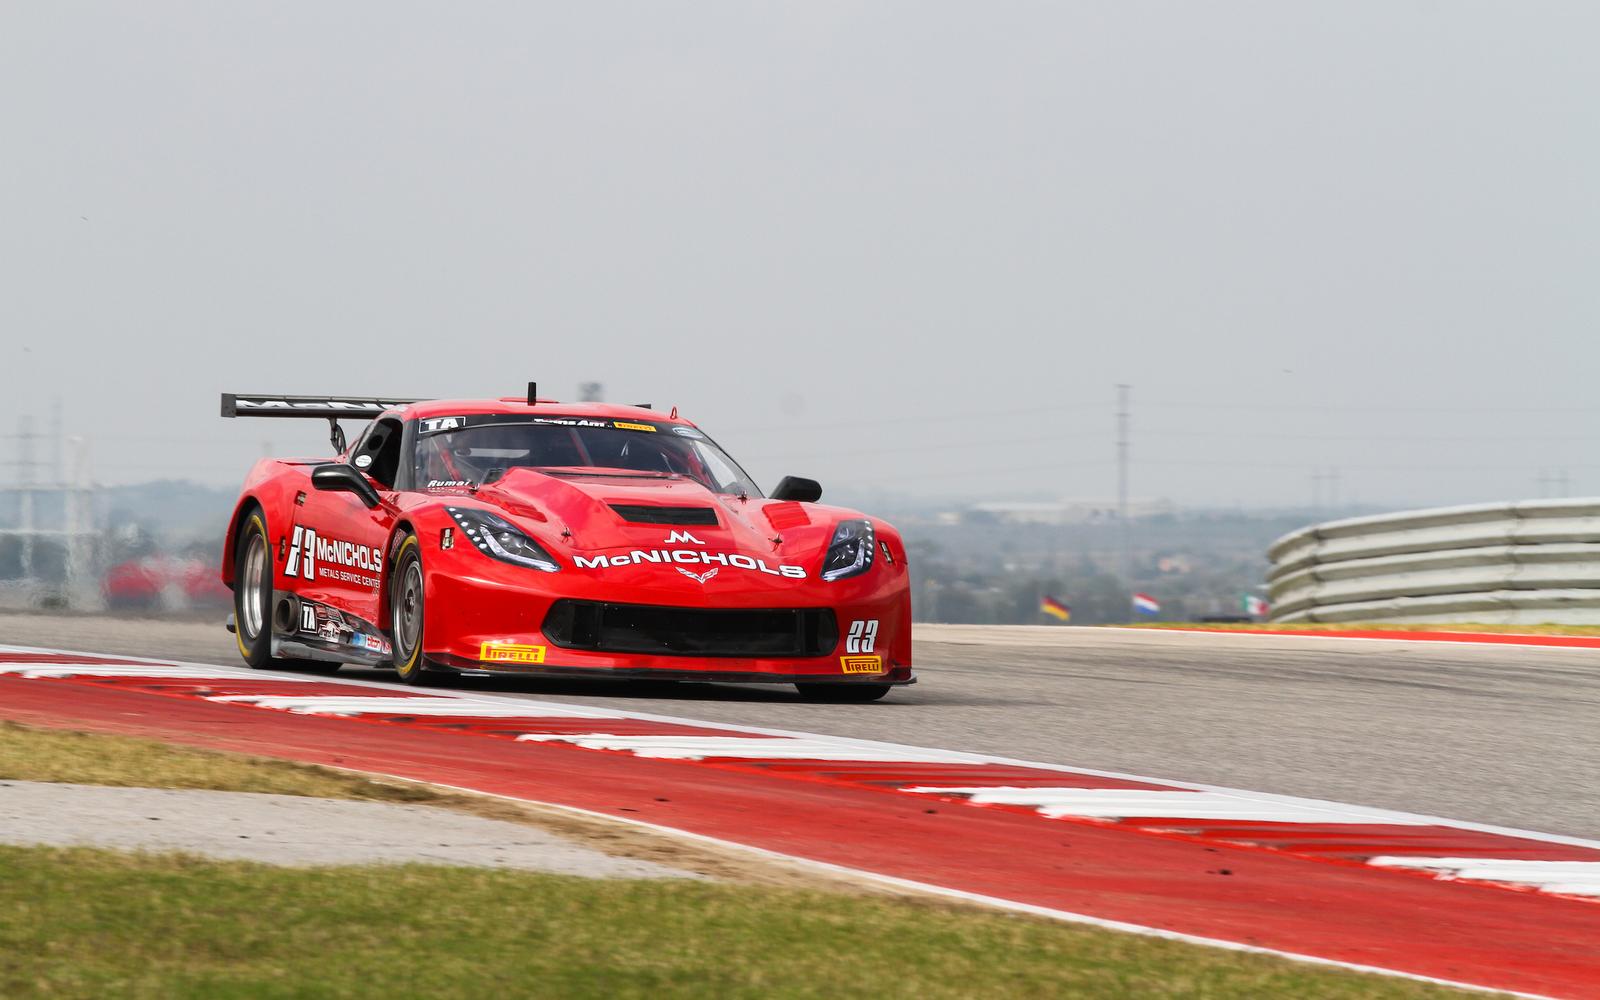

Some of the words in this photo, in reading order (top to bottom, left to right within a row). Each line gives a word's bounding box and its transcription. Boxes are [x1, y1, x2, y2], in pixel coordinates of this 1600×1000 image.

[425, 418, 459, 430] TA
[284, 525, 316, 580] 23
[316, 537, 382, 573] McNICHOLS
[573, 549, 807, 579] McNICHOLS
[319, 567, 340, 580] METALS
[340, 571, 362, 585] SERVICE
[303, 606, 315, 629] TA
[846, 620, 879, 654] 23
[485, 645, 540, 661] PIRELLI
[844, 657, 880, 672] PIRELLI
